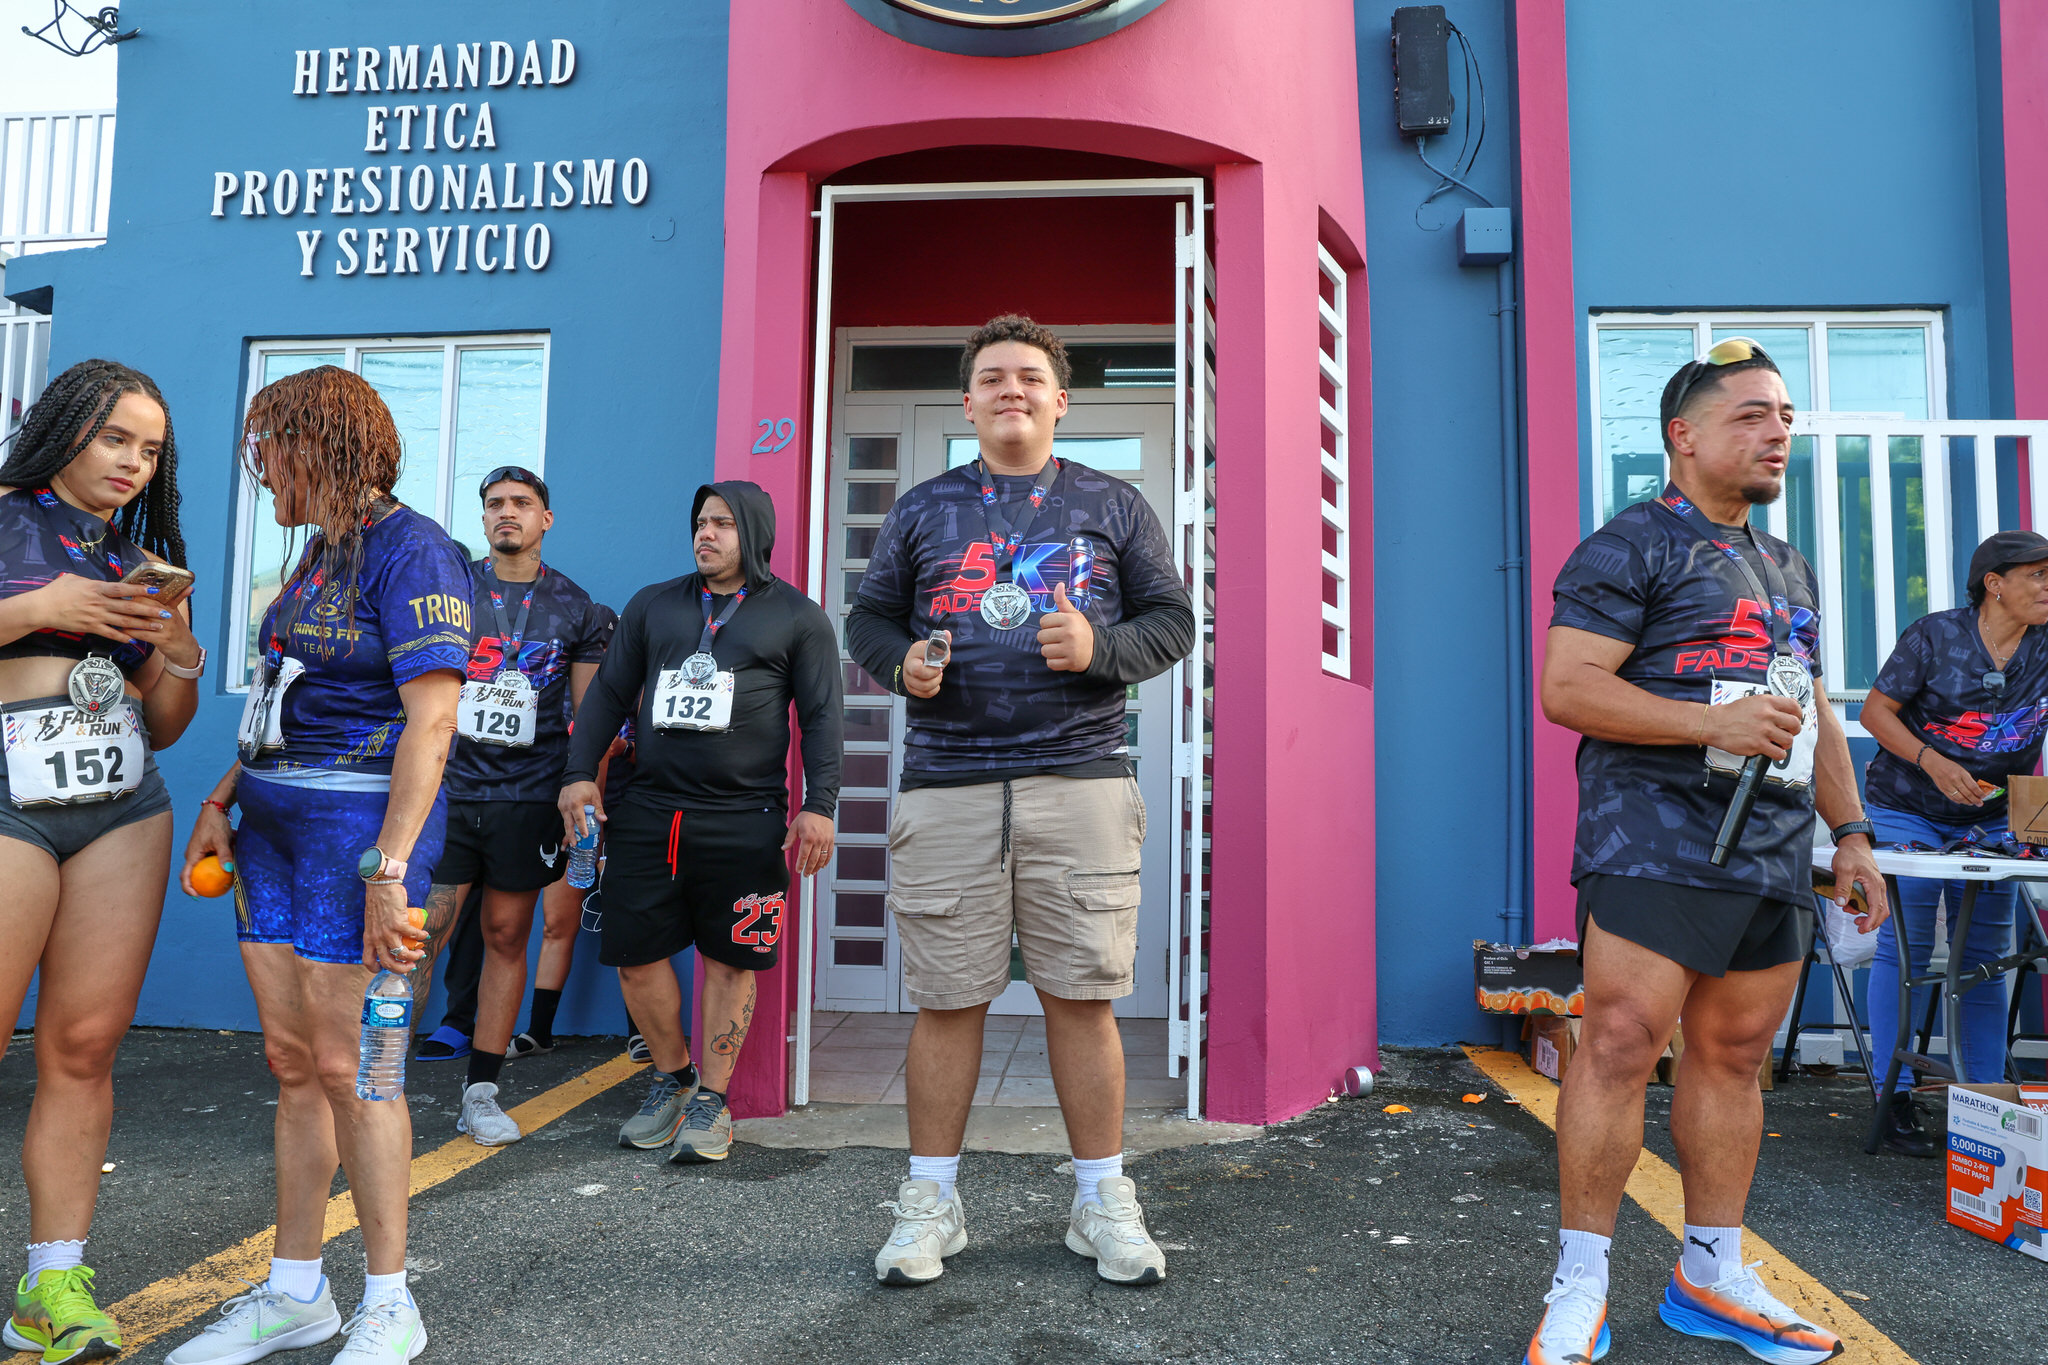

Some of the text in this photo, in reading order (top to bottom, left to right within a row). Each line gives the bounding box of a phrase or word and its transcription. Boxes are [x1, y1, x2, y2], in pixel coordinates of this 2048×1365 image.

[292, 38, 577, 95] HERMANDAD
[364, 101, 497, 152] ETICA
[1427, 116, 1450, 125] 325
[210, 157, 649, 217] PROFESIONALISMO
[296, 222, 551, 276] Y SERVICIO
[751, 417, 796, 455] 29
[950, 542, 1068, 593] 5K
[408, 593, 471, 633] TRIBU
[336, 628, 363, 641] FIT
[303, 641, 335, 656] TEAM
[1674, 647, 1769, 674] FADE
[91, 659, 107, 669] 5K
[487, 687, 517, 699] FADE
[501, 698, 525, 709] RUN
[665, 695, 713, 720] 132
[88, 722, 121, 736] RUN
[473, 709, 521, 737] 129
[45, 746, 124, 789] 152
[731, 899, 786, 946] 23
[1952, 1093, 1999, 1114] MARATHON
[1951, 1136, 1976, 1153] 6,000
[1951, 1154, 1990, 1173] JUMBO 2-PLY
[1951, 1163, 1991, 1183] TOILET PAPER
